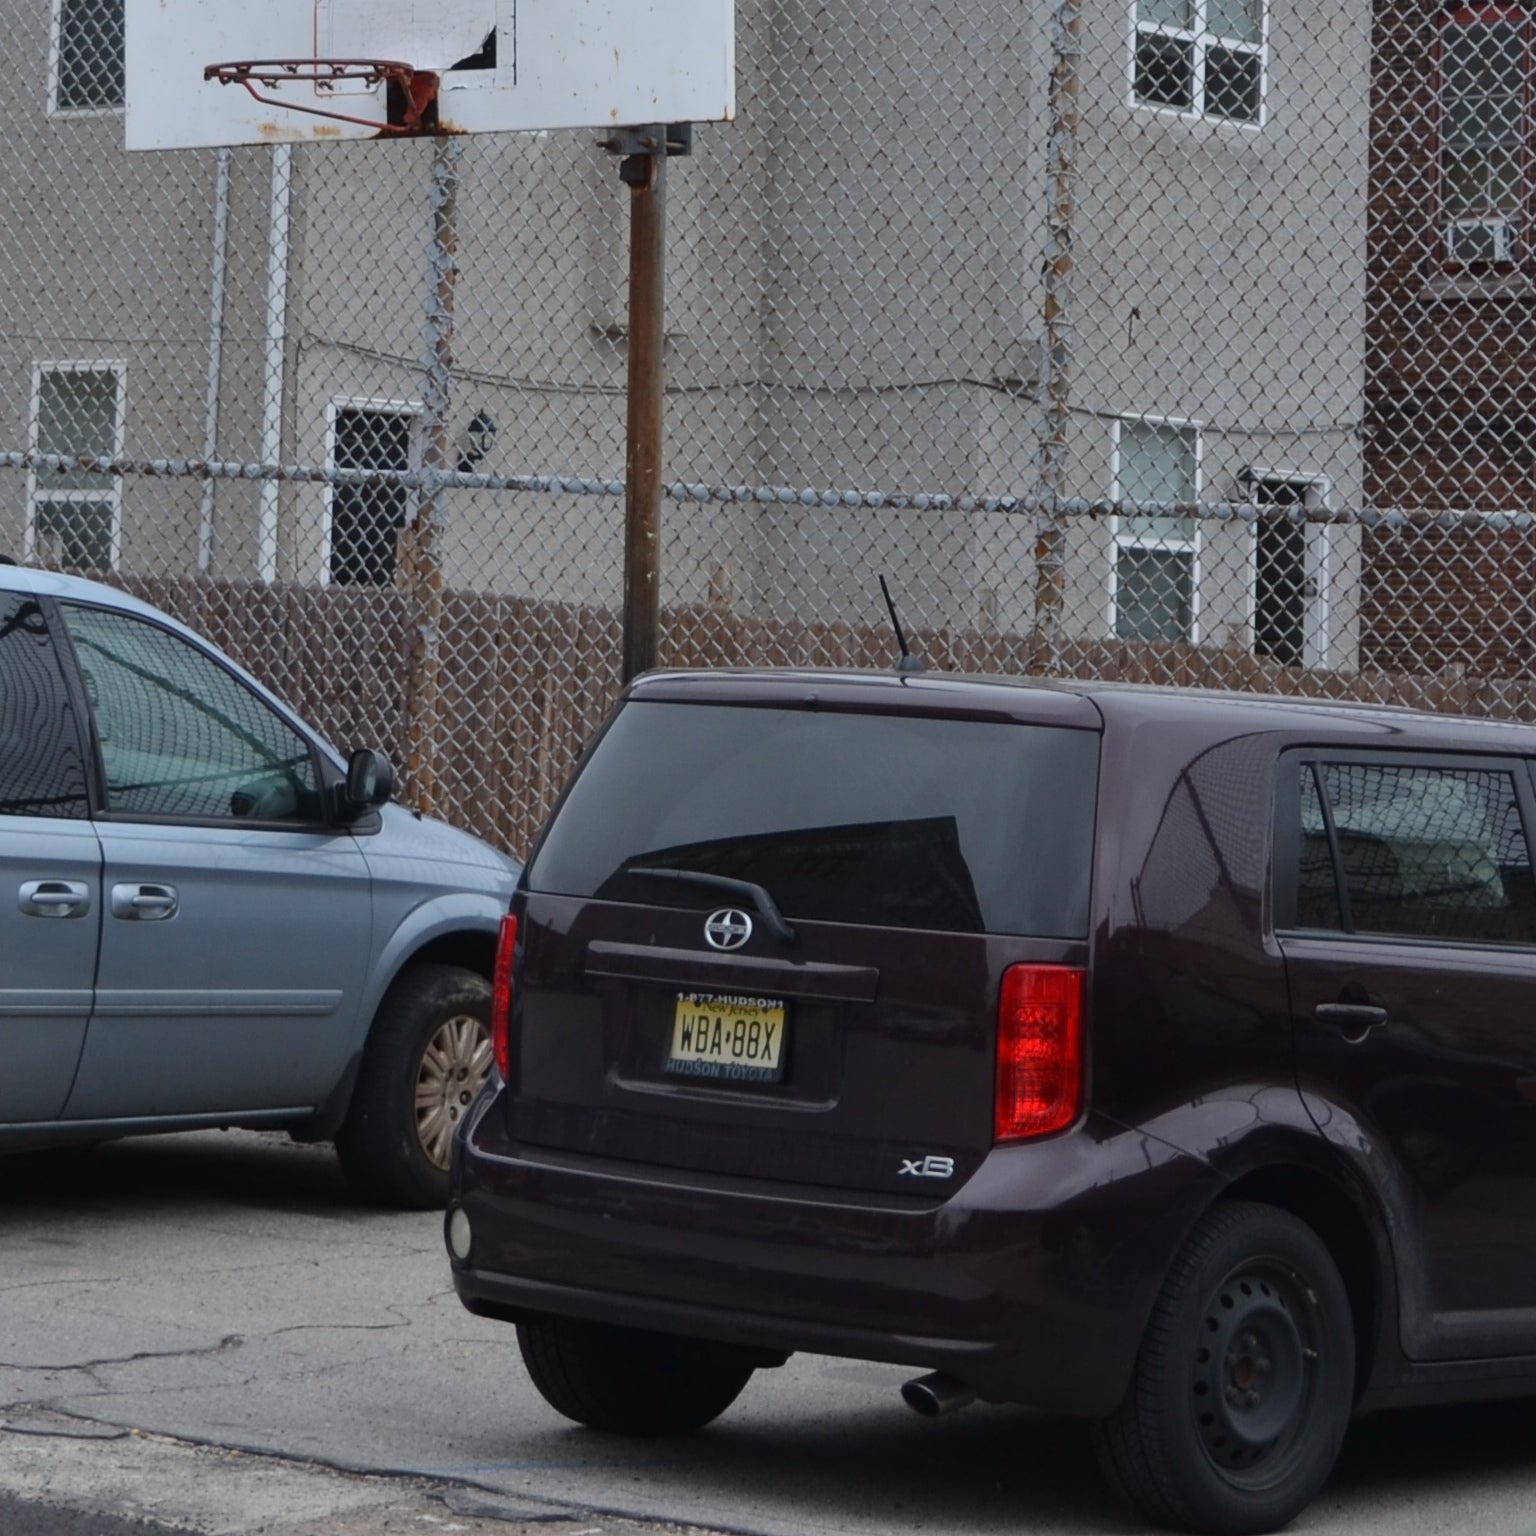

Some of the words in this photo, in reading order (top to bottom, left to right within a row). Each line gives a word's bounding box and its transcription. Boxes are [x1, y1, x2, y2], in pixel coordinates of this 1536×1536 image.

[666, 1059, 721, 1078] HUDSON
[724, 1065, 774, 1081] TOYOTA
[897, 1155, 954, 1178] xB
